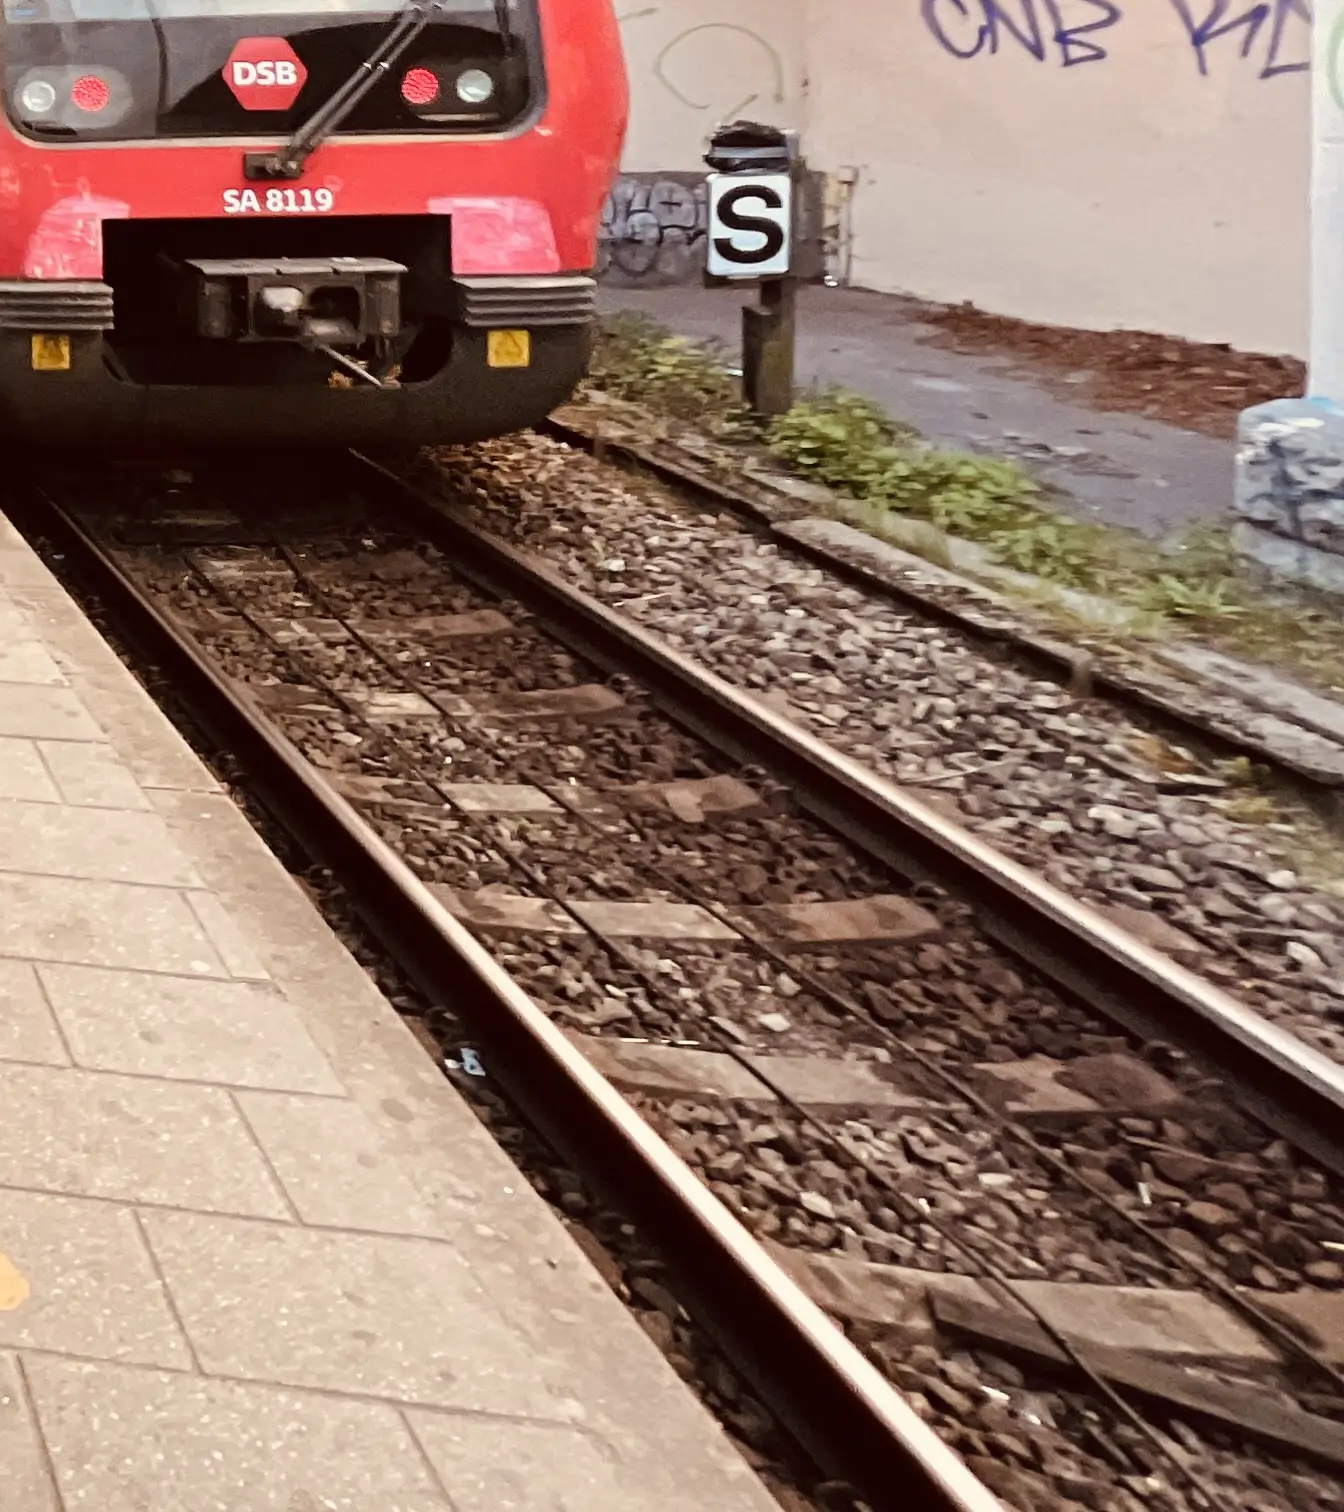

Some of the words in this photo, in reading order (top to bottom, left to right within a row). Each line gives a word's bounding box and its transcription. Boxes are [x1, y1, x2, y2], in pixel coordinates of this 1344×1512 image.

[232, 61, 298, 87] DSB
[222, 188, 261, 213] SA
[265, 188, 334, 213] 8119
[713, 184, 784, 265] S
